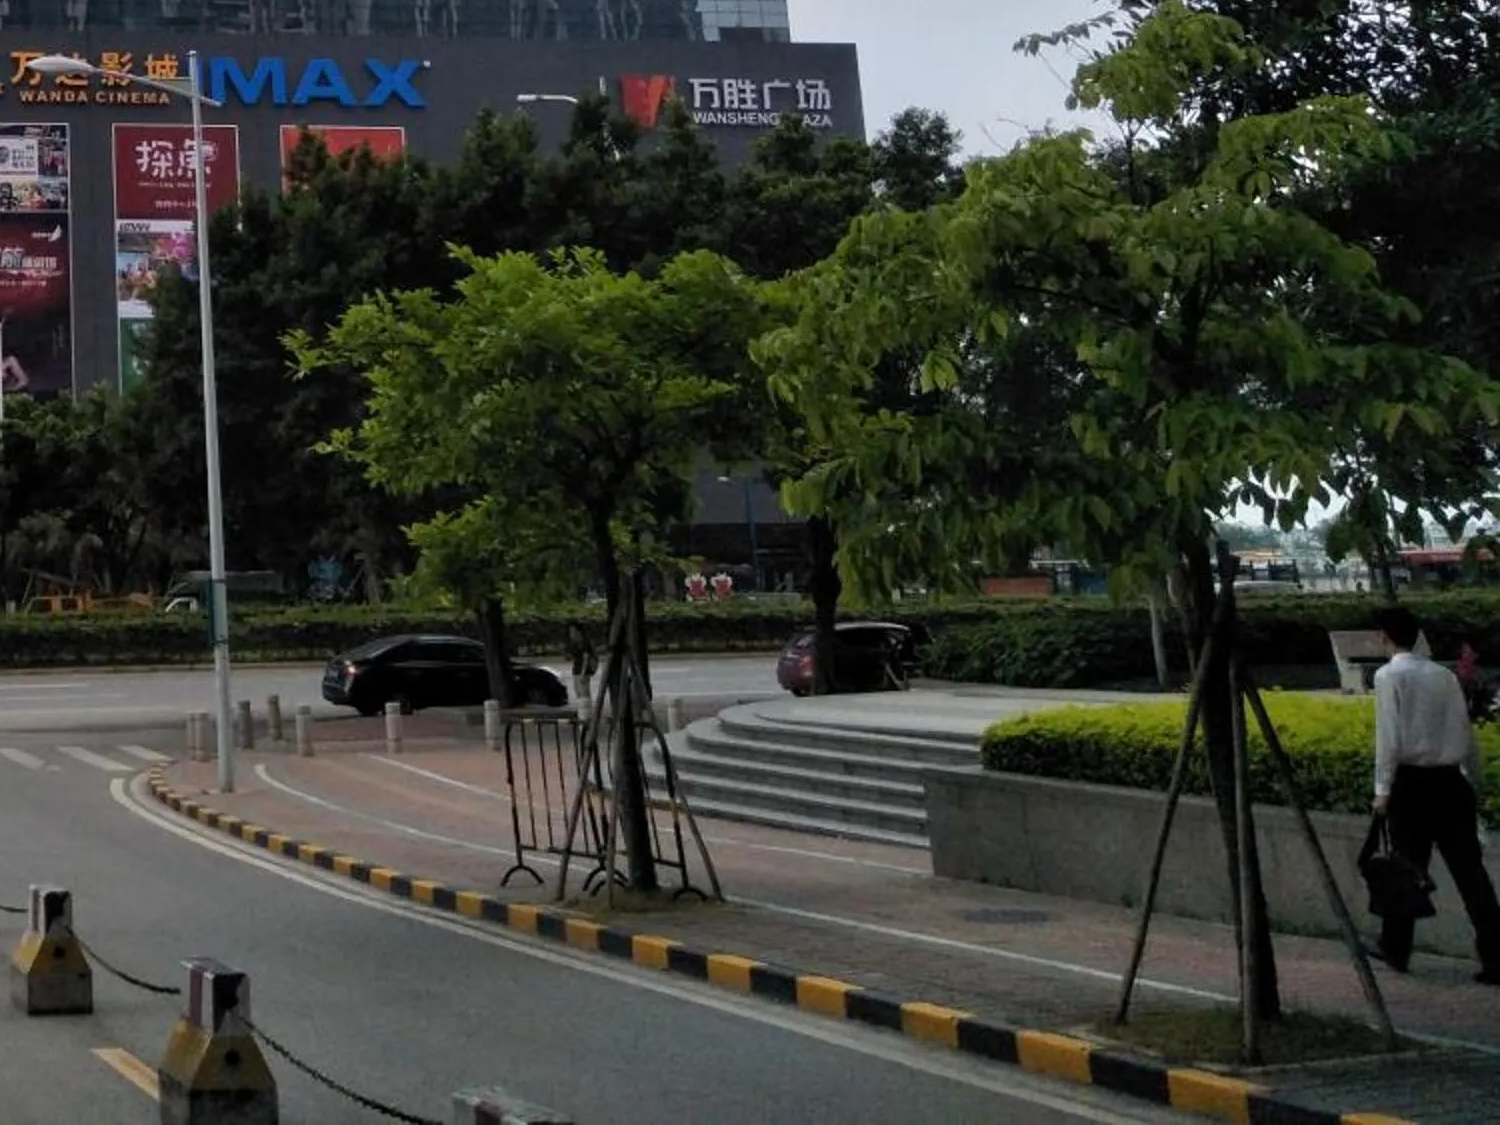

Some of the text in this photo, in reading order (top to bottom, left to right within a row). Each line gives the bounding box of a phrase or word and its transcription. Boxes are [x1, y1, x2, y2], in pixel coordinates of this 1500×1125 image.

[19, 90, 171, 104] WANDA CINEMA
[687, 78, 832, 110] 万胜广场
[692, 112, 781, 125] WANSHENG
